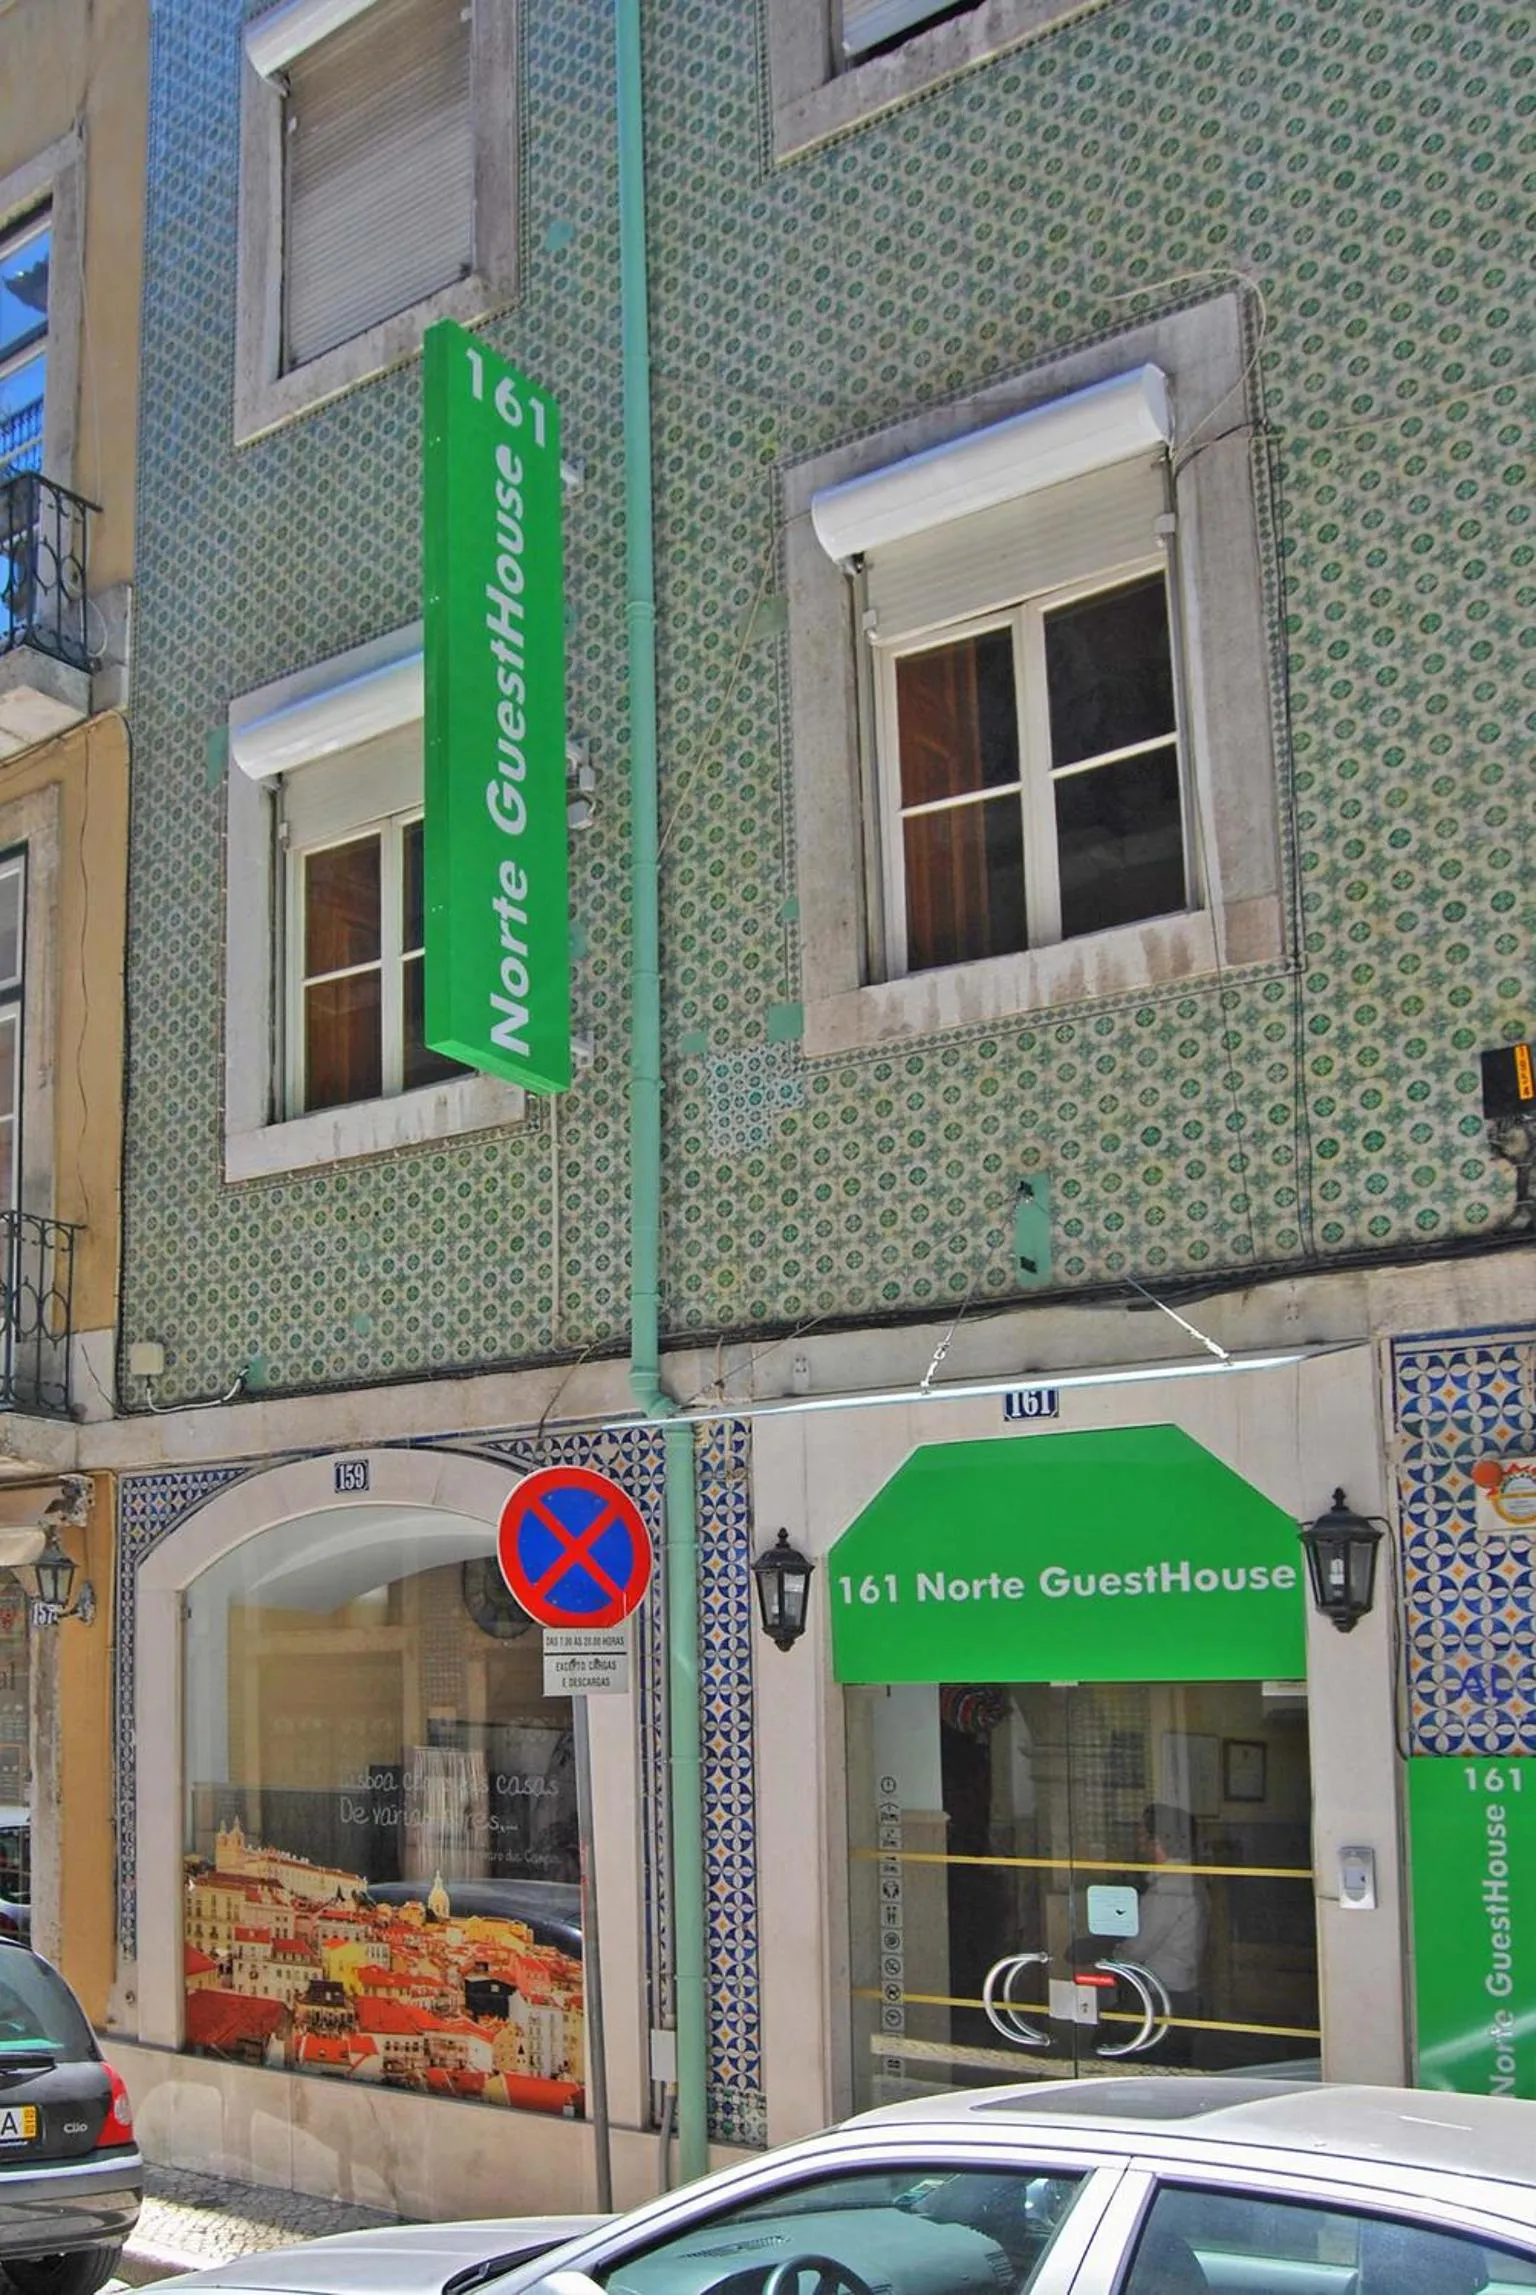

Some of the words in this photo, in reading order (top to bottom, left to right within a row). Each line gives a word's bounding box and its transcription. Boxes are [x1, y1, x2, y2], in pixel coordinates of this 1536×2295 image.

[466, 349, 545, 445] 161
[486, 445, 526, 835] GuestHouse
[490, 860, 529, 1056] Norte
[1011, 1389, 1051, 1417] 161
[339, 1463, 366, 1490] 159
[838, 1574, 898, 1604] 161
[917, 1572, 1025, 1601] Norte
[1039, 1561, 1296, 1597] GuestHouse
[545, 1635, 558, 1647] DAS
[602, 1635, 625, 1647] HORAS
[556, 1660, 586, 1673] EXCEPTO
[588, 1659, 617, 1672] CARGAS
[562, 1677, 567, 1689] E
[568, 1676, 611, 1689] DESCARGAS
[496, 1774, 559, 1797] casas
[1464, 1767, 1523, 1792] 161
[340, 1796, 370, 1825] De
[1482, 1803, 1513, 1997] GuestHouse
[1488, 2008, 1517, 2099] Norte
[63, 2121, 89, 2134] Clio
